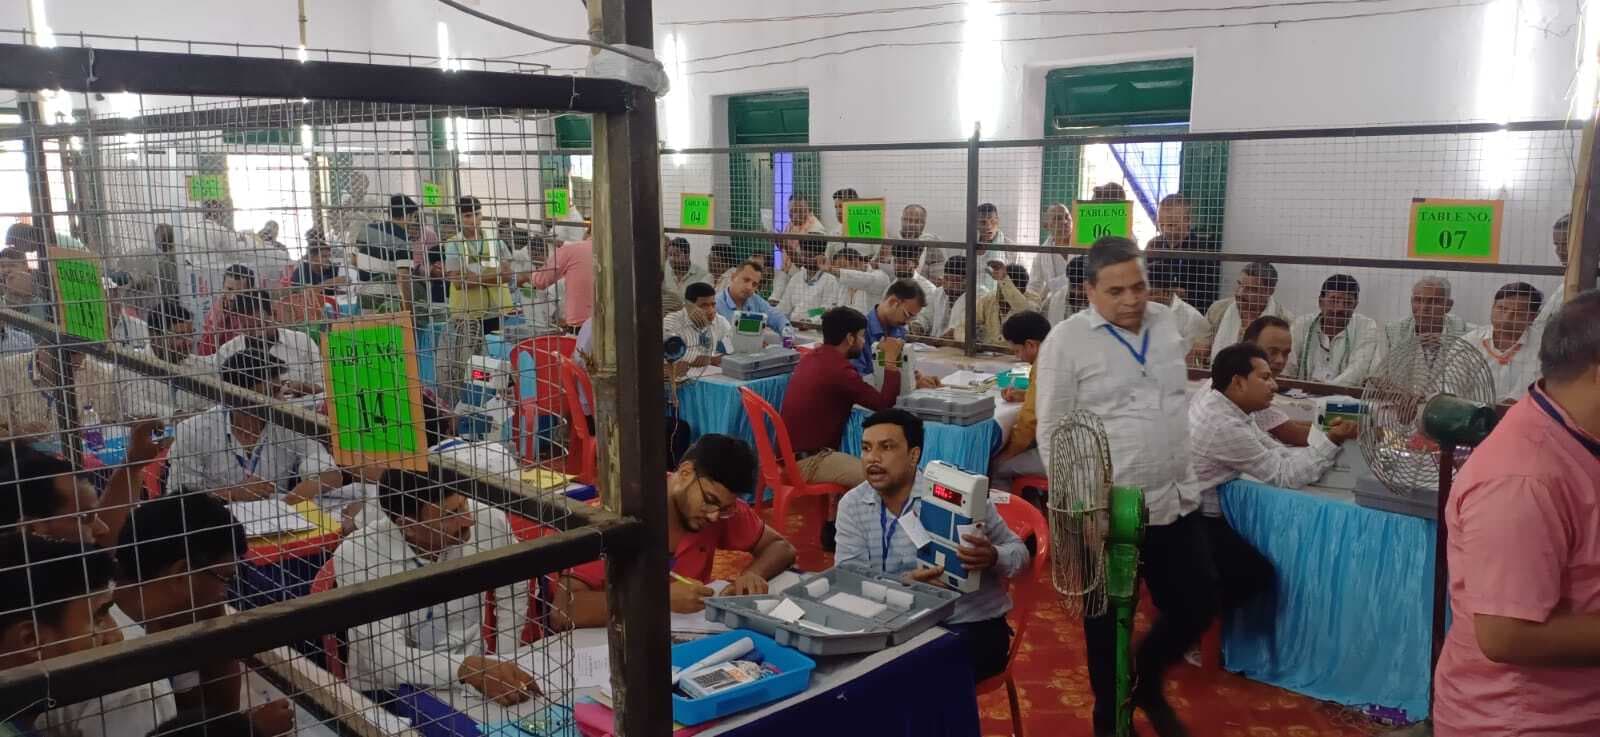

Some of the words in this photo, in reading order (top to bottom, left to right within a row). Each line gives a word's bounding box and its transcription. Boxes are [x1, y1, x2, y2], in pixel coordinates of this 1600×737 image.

[690, 210, 701, 222] 04
[848, 208, 868, 216] TABLE
[1080, 208, 1110, 217] TABLE
[1111, 207, 1127, 217] NO.
[1418, 211, 1463, 221] TABLE
[1467, 212, 1491, 222] NO.
[857, 221, 872, 234] 05
[1439, 230, 1468, 250] 07
[357, 387, 387, 433] 14
